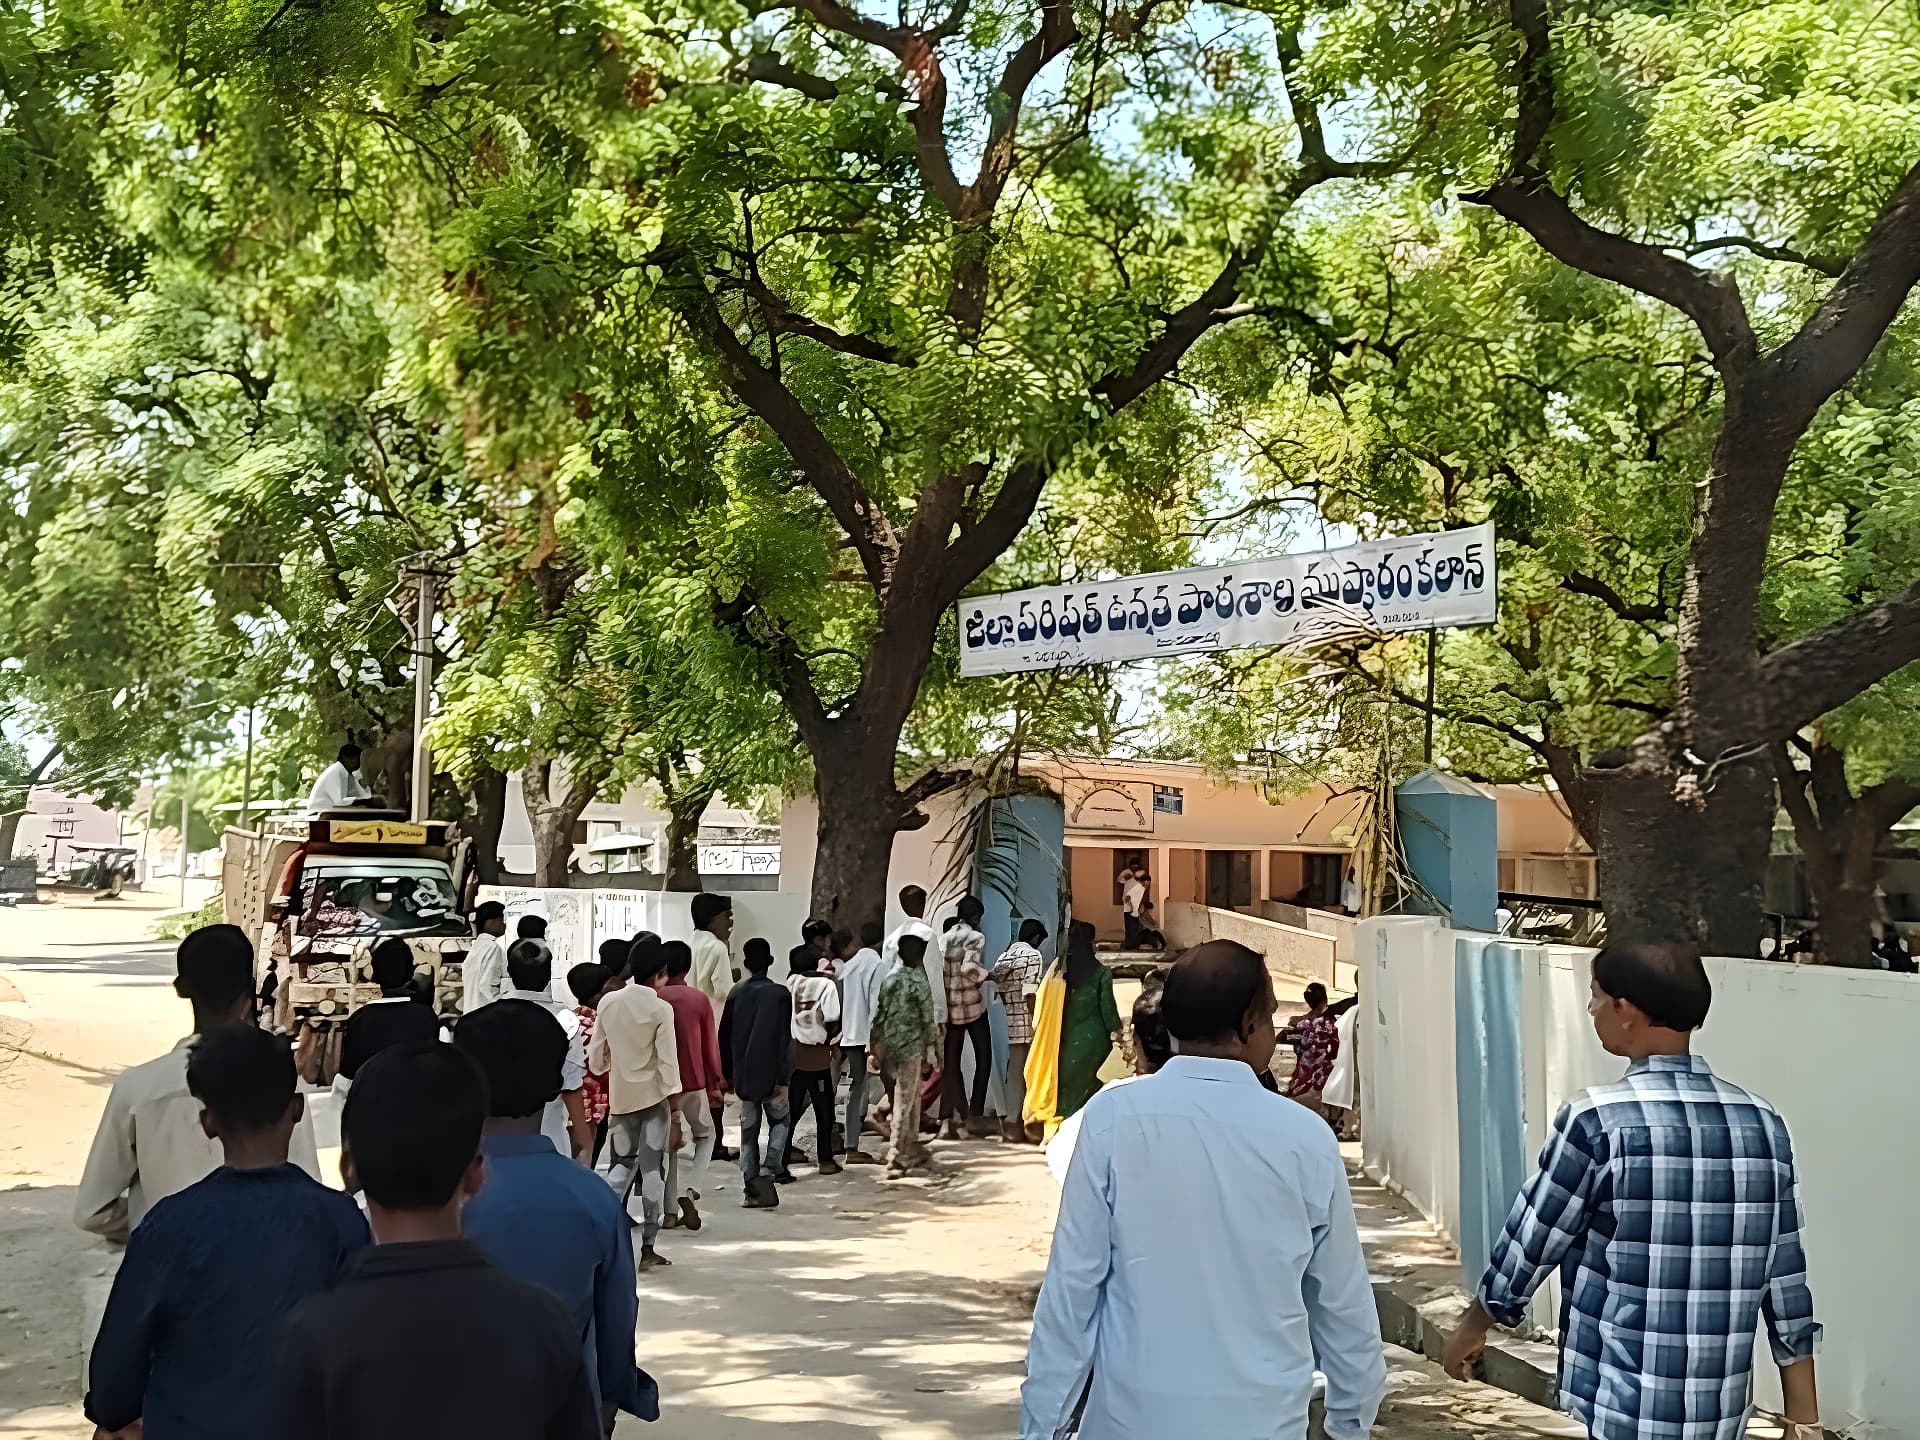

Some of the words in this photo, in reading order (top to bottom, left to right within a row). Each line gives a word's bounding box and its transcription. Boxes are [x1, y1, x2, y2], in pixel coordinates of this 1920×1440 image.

[966, 609, 1015, 648] జిల్లా
[1018, 592, 1102, 642] పరిషత్
[1107, 584, 1172, 635] ఉన్నత
[1177, 575, 1296, 625] పాఠశాల
